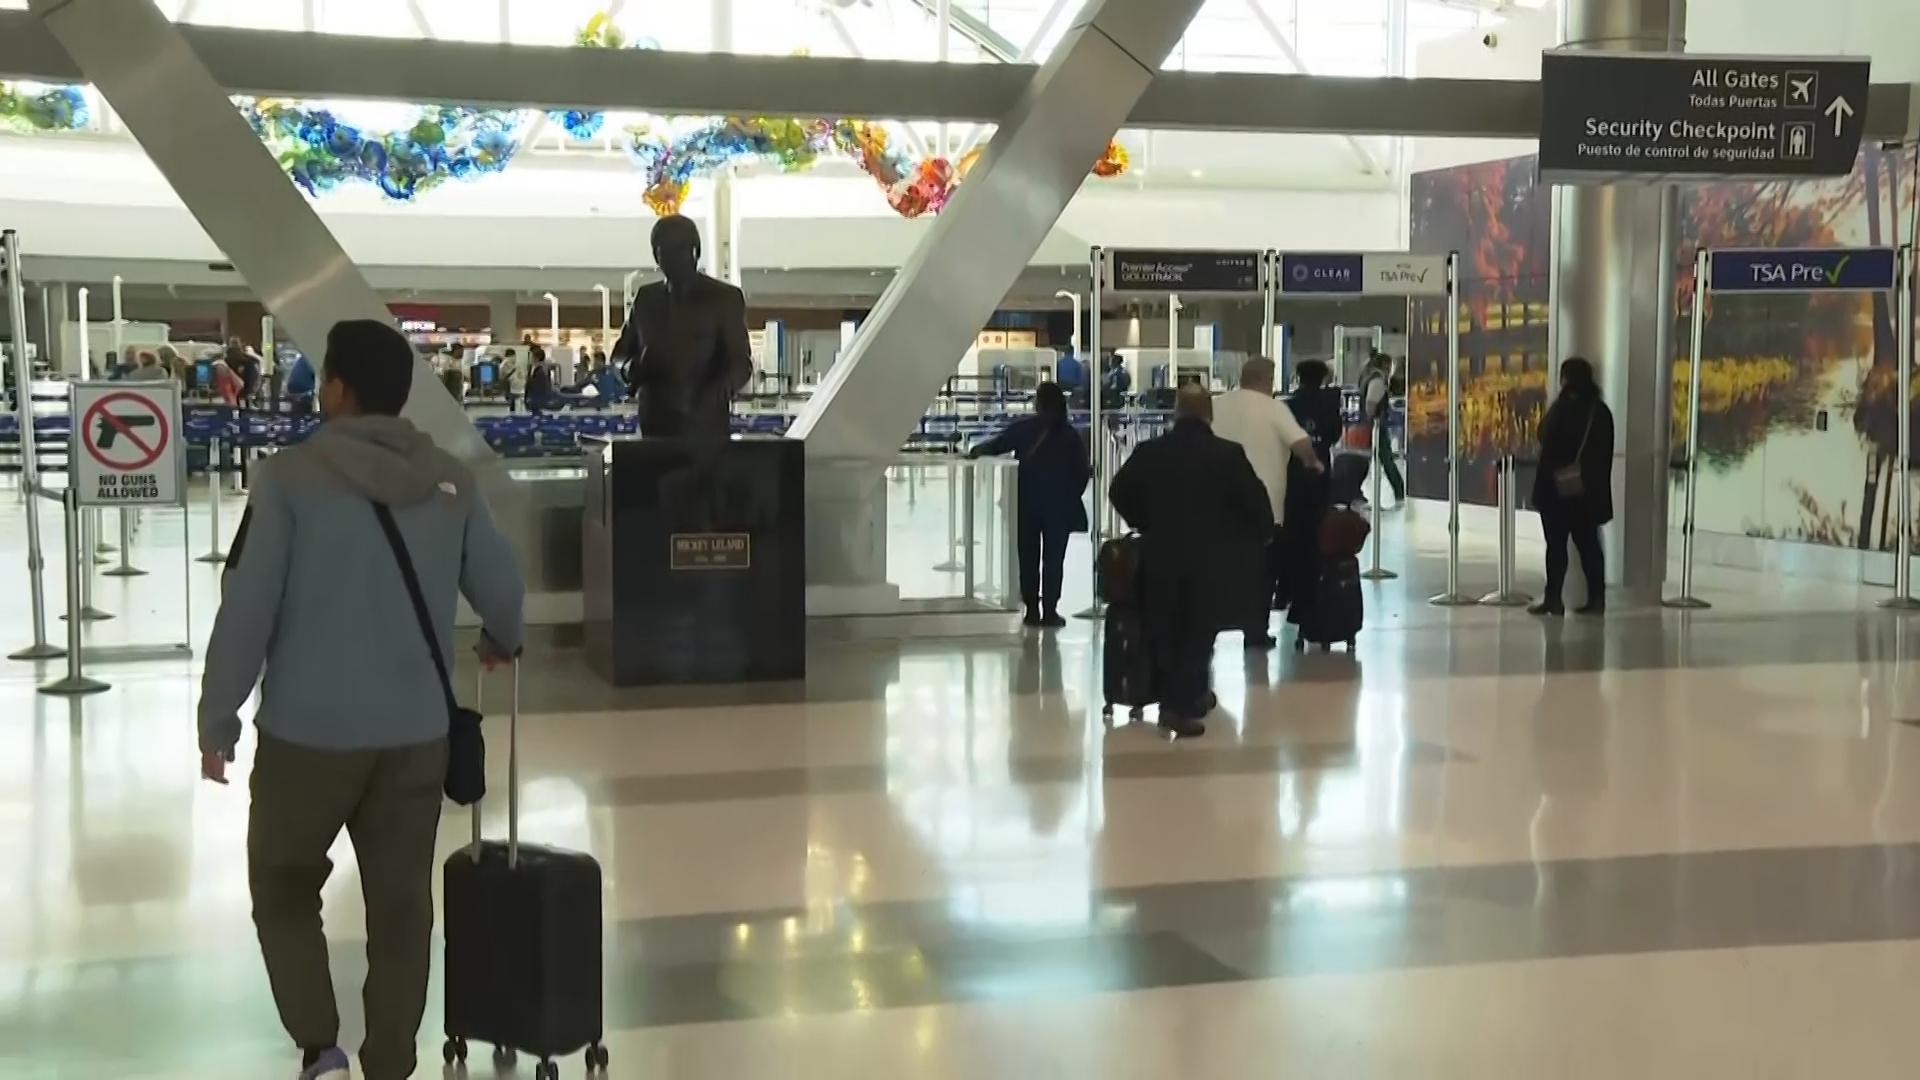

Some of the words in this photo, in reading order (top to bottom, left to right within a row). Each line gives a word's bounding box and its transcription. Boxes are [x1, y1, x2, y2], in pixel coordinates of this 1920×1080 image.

[1692, 69, 1718, 87] All
[1725, 71, 1779, 88] Gates
[1690, 94, 1725, 108] Todas
[1729, 95, 1777, 108] Puertas
[1585, 117, 1663, 141] Security
[1669, 121, 1776, 143] Checkpoint
[1578, 143, 1621, 156] Puesto
[1625, 144, 1641, 156] de
[1645, 145, 1689, 158] control
[1693, 146, 1709, 159] de
[1713, 146, 1775, 161] seguridad
[1313, 268, 1351, 279] CLEAR
[1750, 263, 1786, 282] TSA
[98, 474, 117, 486] NO
[121, 474, 156, 486] GUNS
[97, 486, 158, 498] ALLOWED
